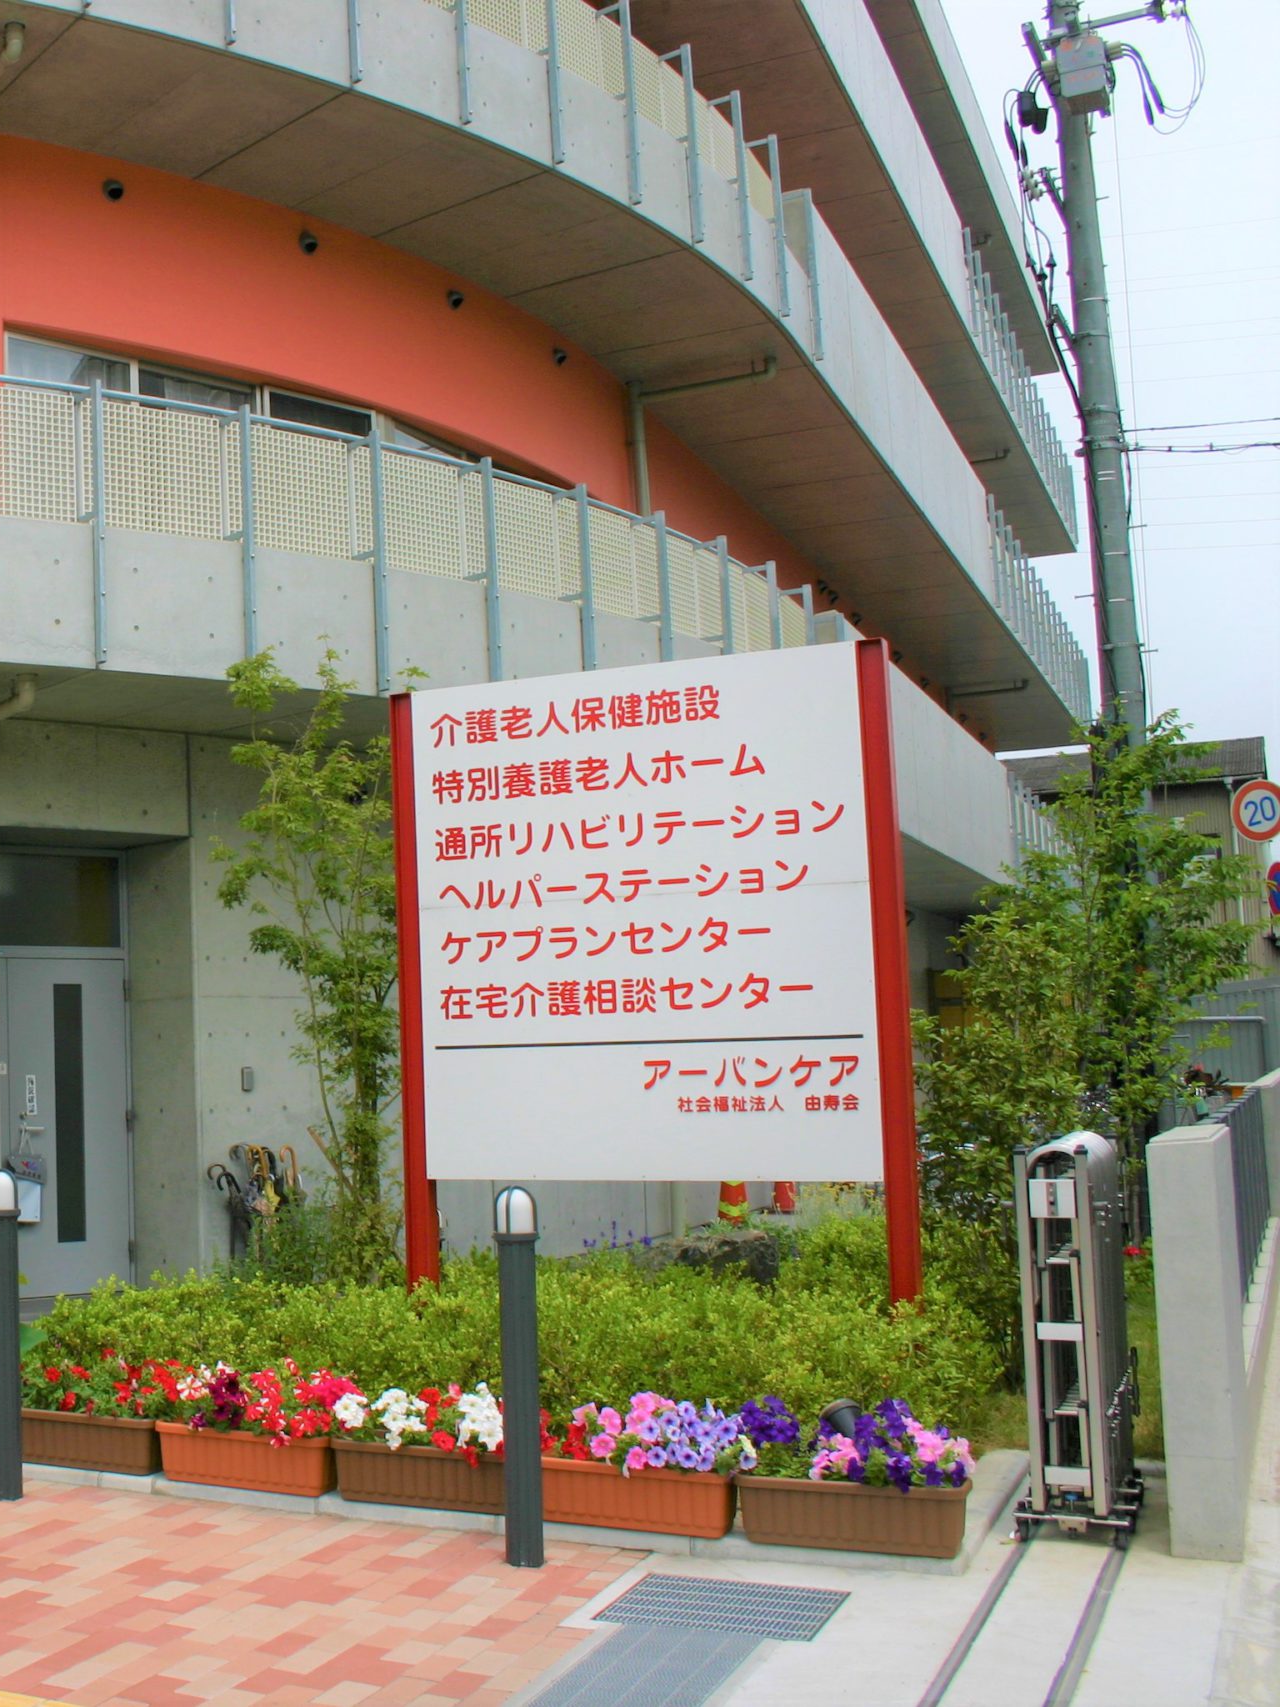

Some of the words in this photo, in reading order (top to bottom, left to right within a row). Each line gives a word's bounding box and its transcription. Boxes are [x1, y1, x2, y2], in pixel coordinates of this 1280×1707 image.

[431, 684, 720, 748] 介護老人保健施設
[432, 743, 766, 804] 特別養護老人ホーム
[435, 800, 844, 862] 通所リハビリテーション
[1244, 795, 1276, 827] 20
[440, 860, 809, 910] ヘルパーステーション
[441, 916, 771, 965] ケアプランセンター
[440, 972, 813, 1020] 在宅介護相談センター
[643, 1055, 860, 1091] アーバンケア
[677, 1095, 785, 1113] 社会福祉法人
[804, 1093, 860, 1111] 由寿会
